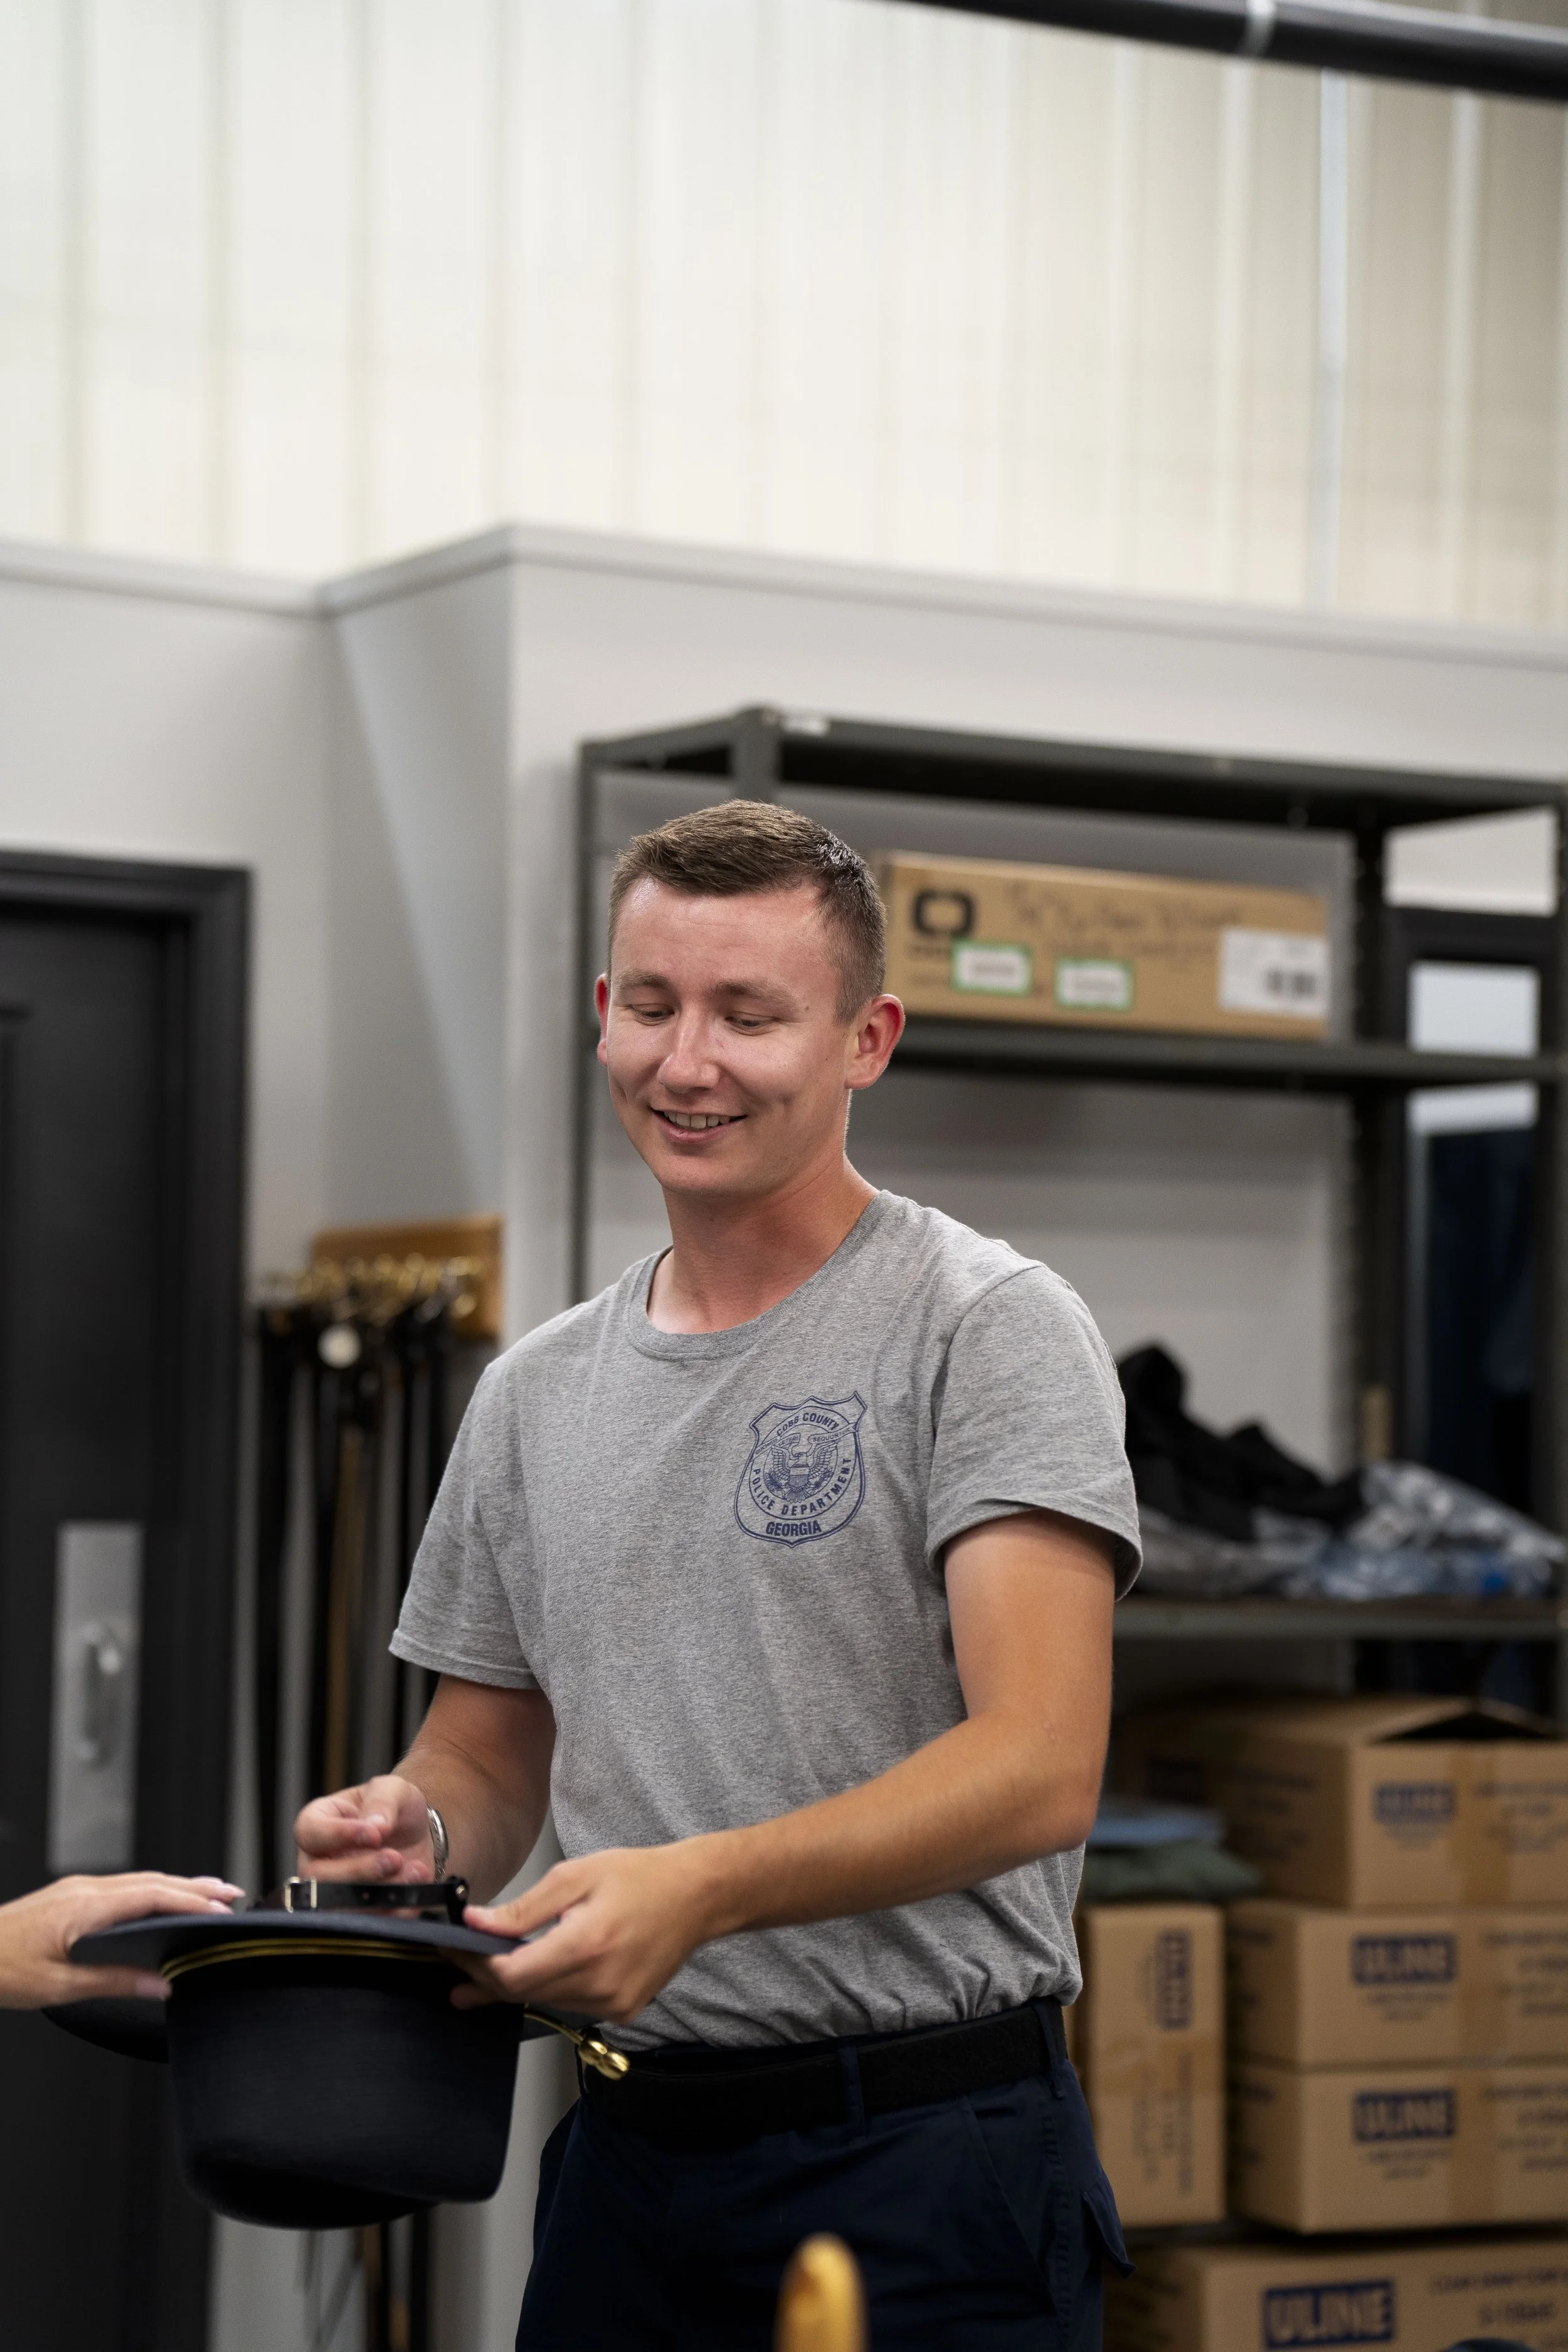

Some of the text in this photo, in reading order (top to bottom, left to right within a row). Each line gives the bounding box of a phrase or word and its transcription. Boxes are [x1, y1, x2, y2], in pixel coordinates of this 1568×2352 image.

[777, 1412, 840, 1437] COBB COUNTY
[753, 1458, 852, 1516] POLICE DEPARTMENT
[765, 1520, 822, 1537] GEORGIA
[1267, 2288, 1386, 2343] ULINE
